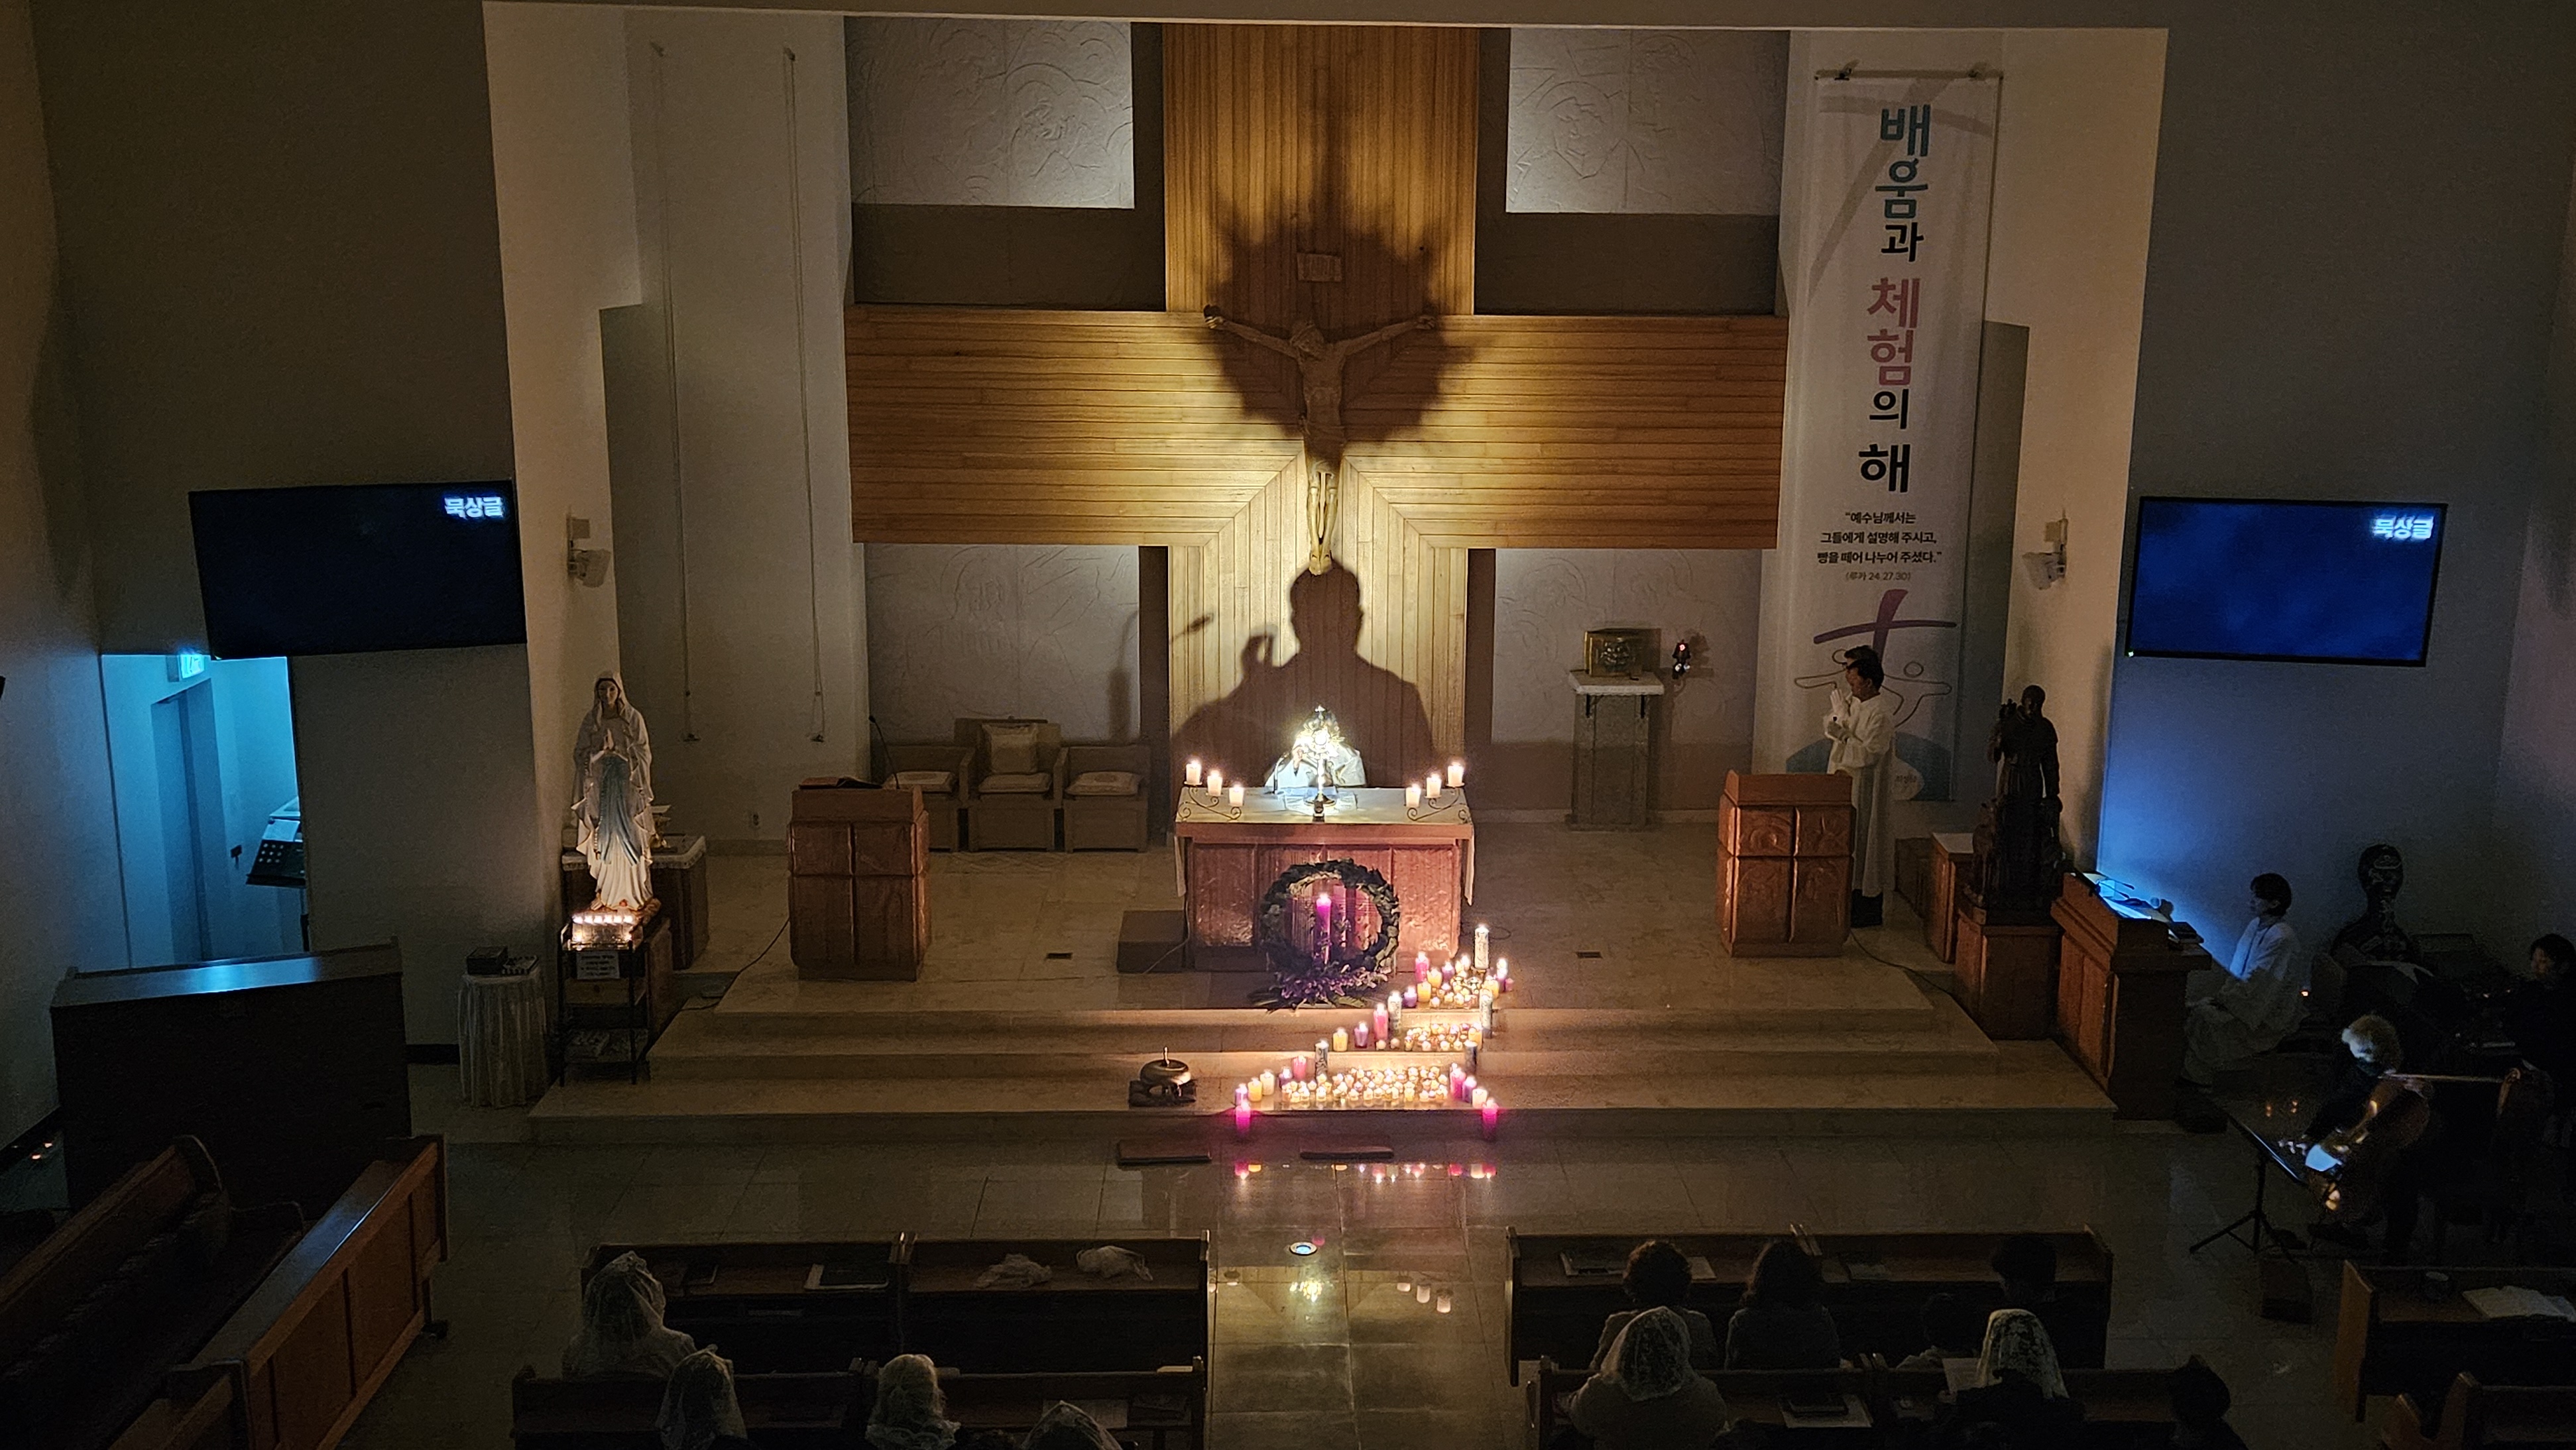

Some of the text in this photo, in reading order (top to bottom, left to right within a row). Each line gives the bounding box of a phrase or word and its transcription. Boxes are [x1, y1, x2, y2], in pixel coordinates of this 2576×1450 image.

[1858, 103, 1931, 493] 배움과 체험의 해
[443, 496, 504, 520] 묵상글
[1820, 531, 1937, 544] 그들에게 설명해 주시고,
[2372, 516, 2434, 539] 묵상글
[1817, 551, 1839, 564] 빵을
[1841, 551, 1863, 564] 떼어
[1865, 551, 1898, 564] 나누어
